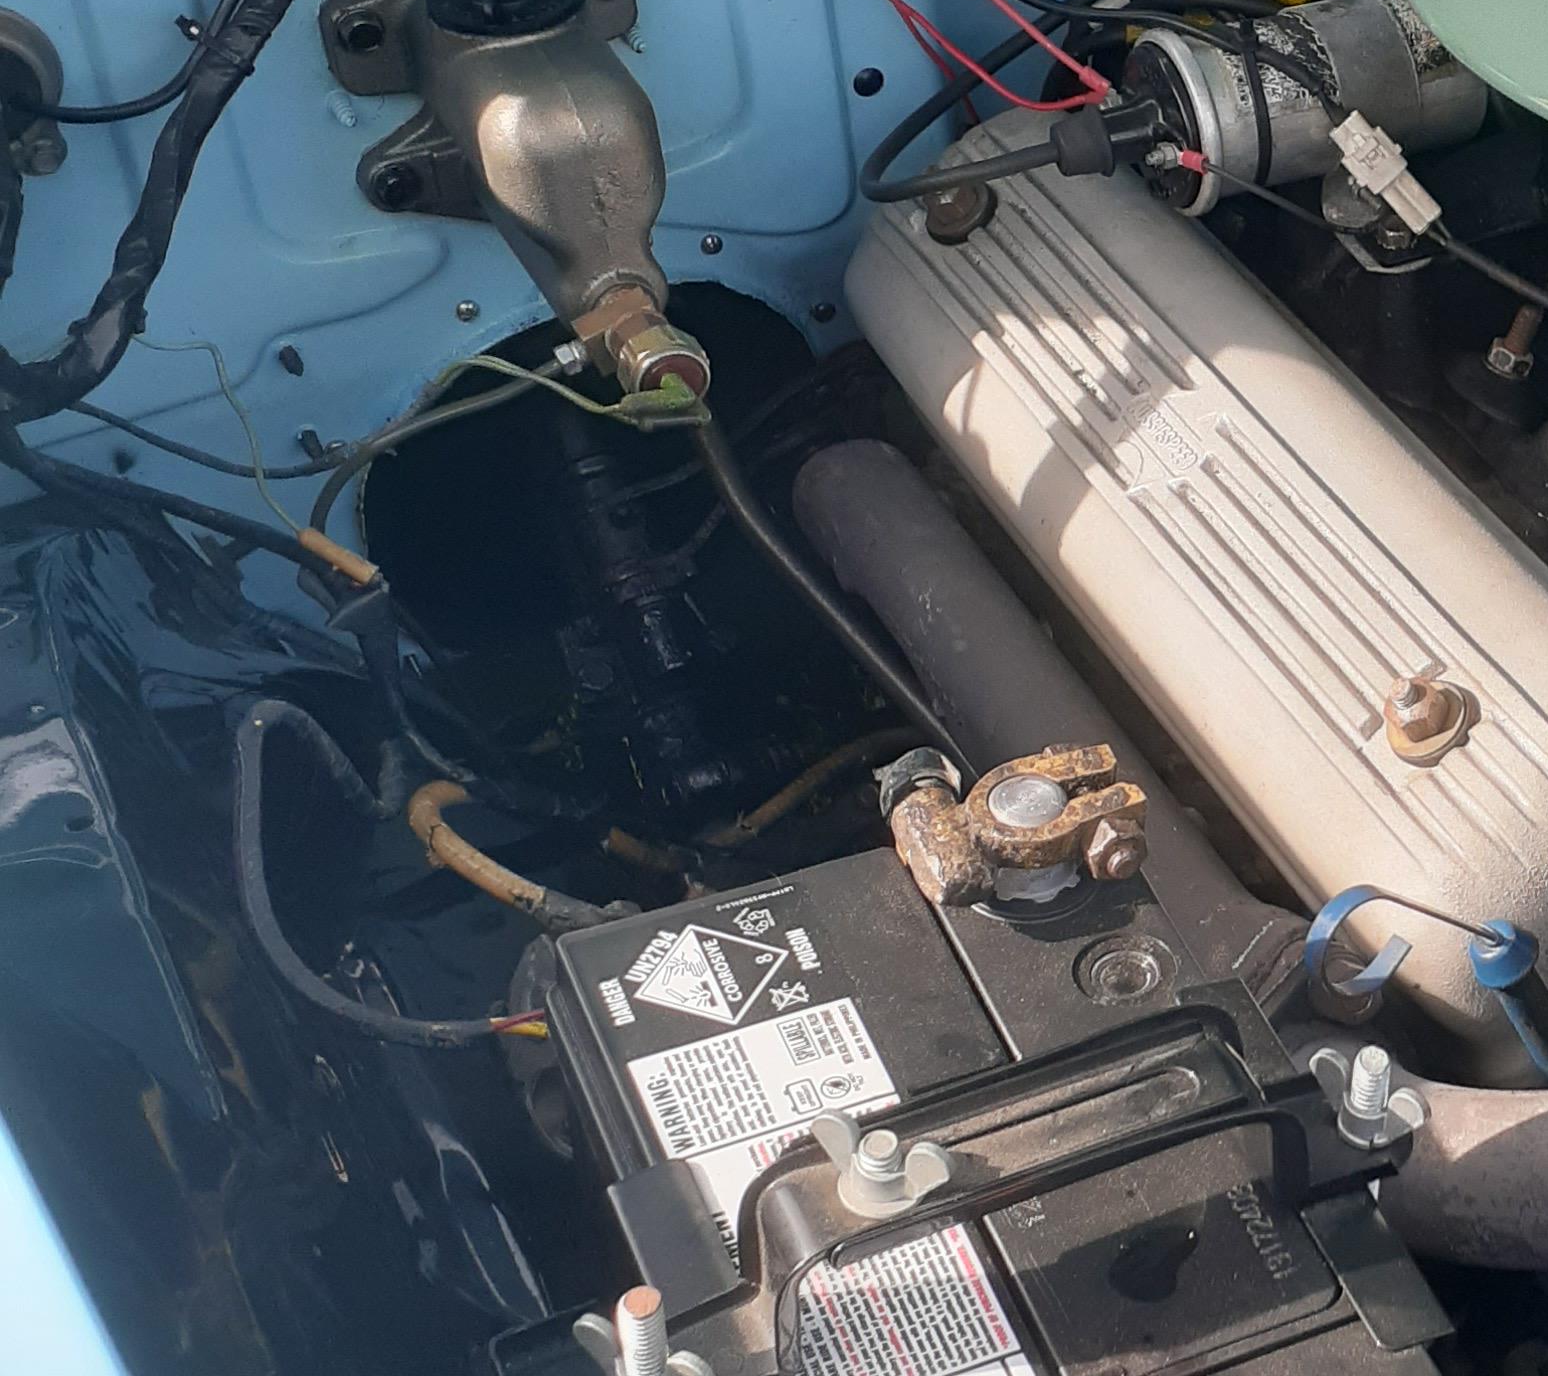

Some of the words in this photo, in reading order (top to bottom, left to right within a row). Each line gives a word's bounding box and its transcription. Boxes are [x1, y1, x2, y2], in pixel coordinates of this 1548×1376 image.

[626, 930, 676, 980] UN2794
[702, 937, 743, 1002] CORROSIVE
[753, 952, 775, 965] 8
[784, 926, 821, 970] POISON
[596, 976, 636, 1027] DANGER
[783, 1022, 814, 1060] SPILLABLE
[648, 1073, 694, 1152] WARNING:
